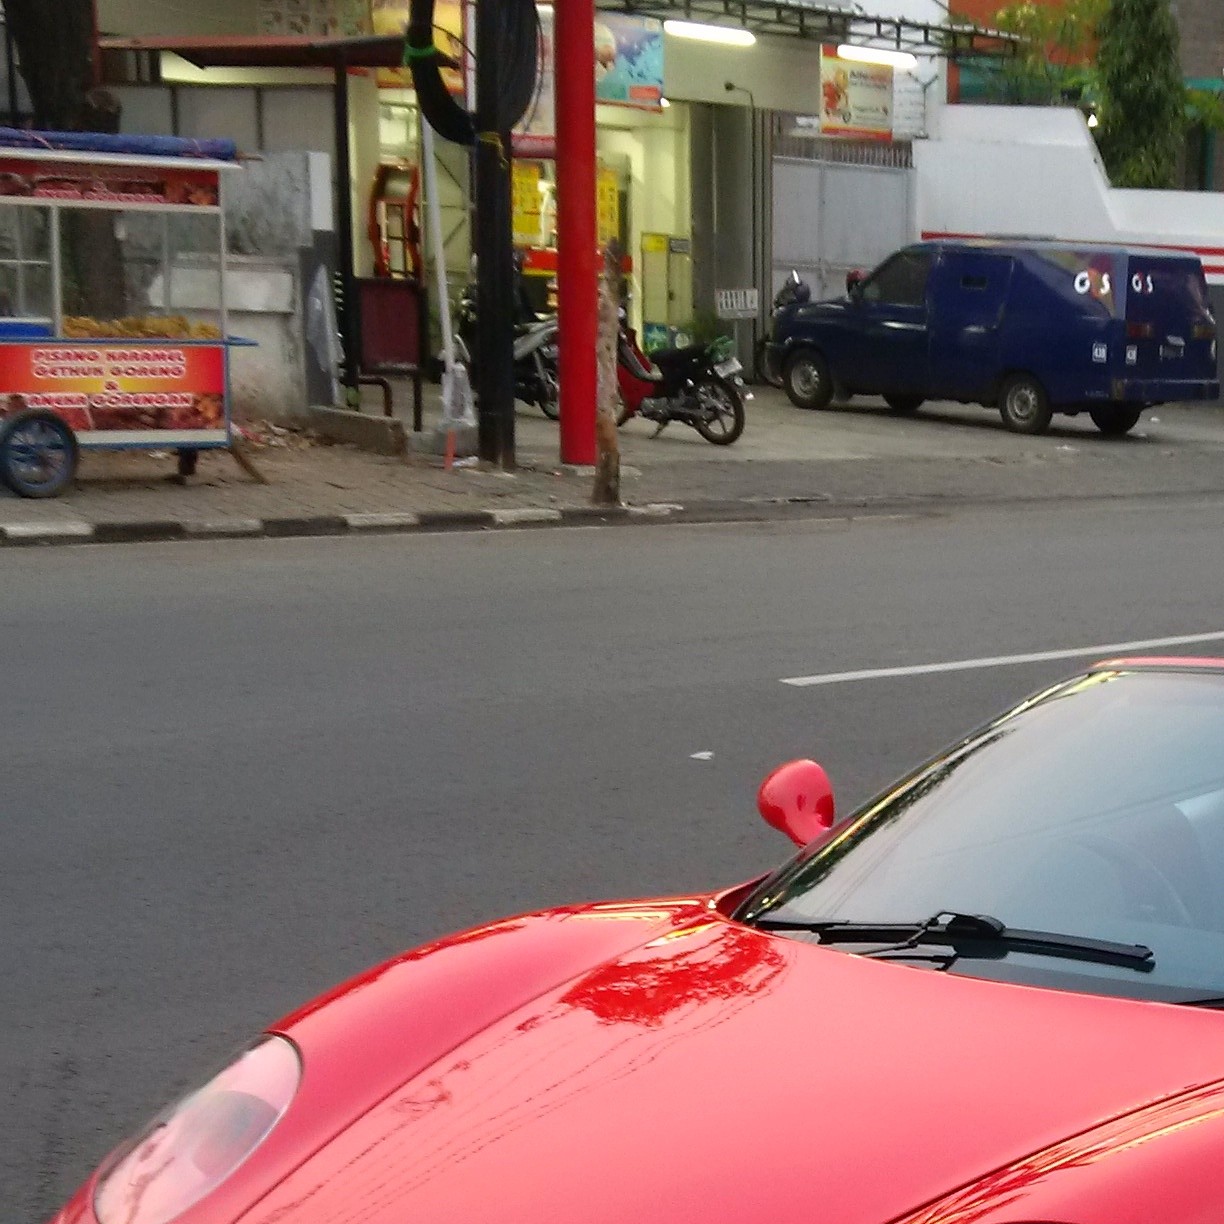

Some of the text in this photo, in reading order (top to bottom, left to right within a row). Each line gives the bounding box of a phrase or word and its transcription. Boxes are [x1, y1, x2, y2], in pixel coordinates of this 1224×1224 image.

[32, 349, 187, 364] PISANG KARAMEL
[34, 365, 187, 379] GETHUK GORENG
[27, 393, 193, 408] ANEKA GORENGAN
